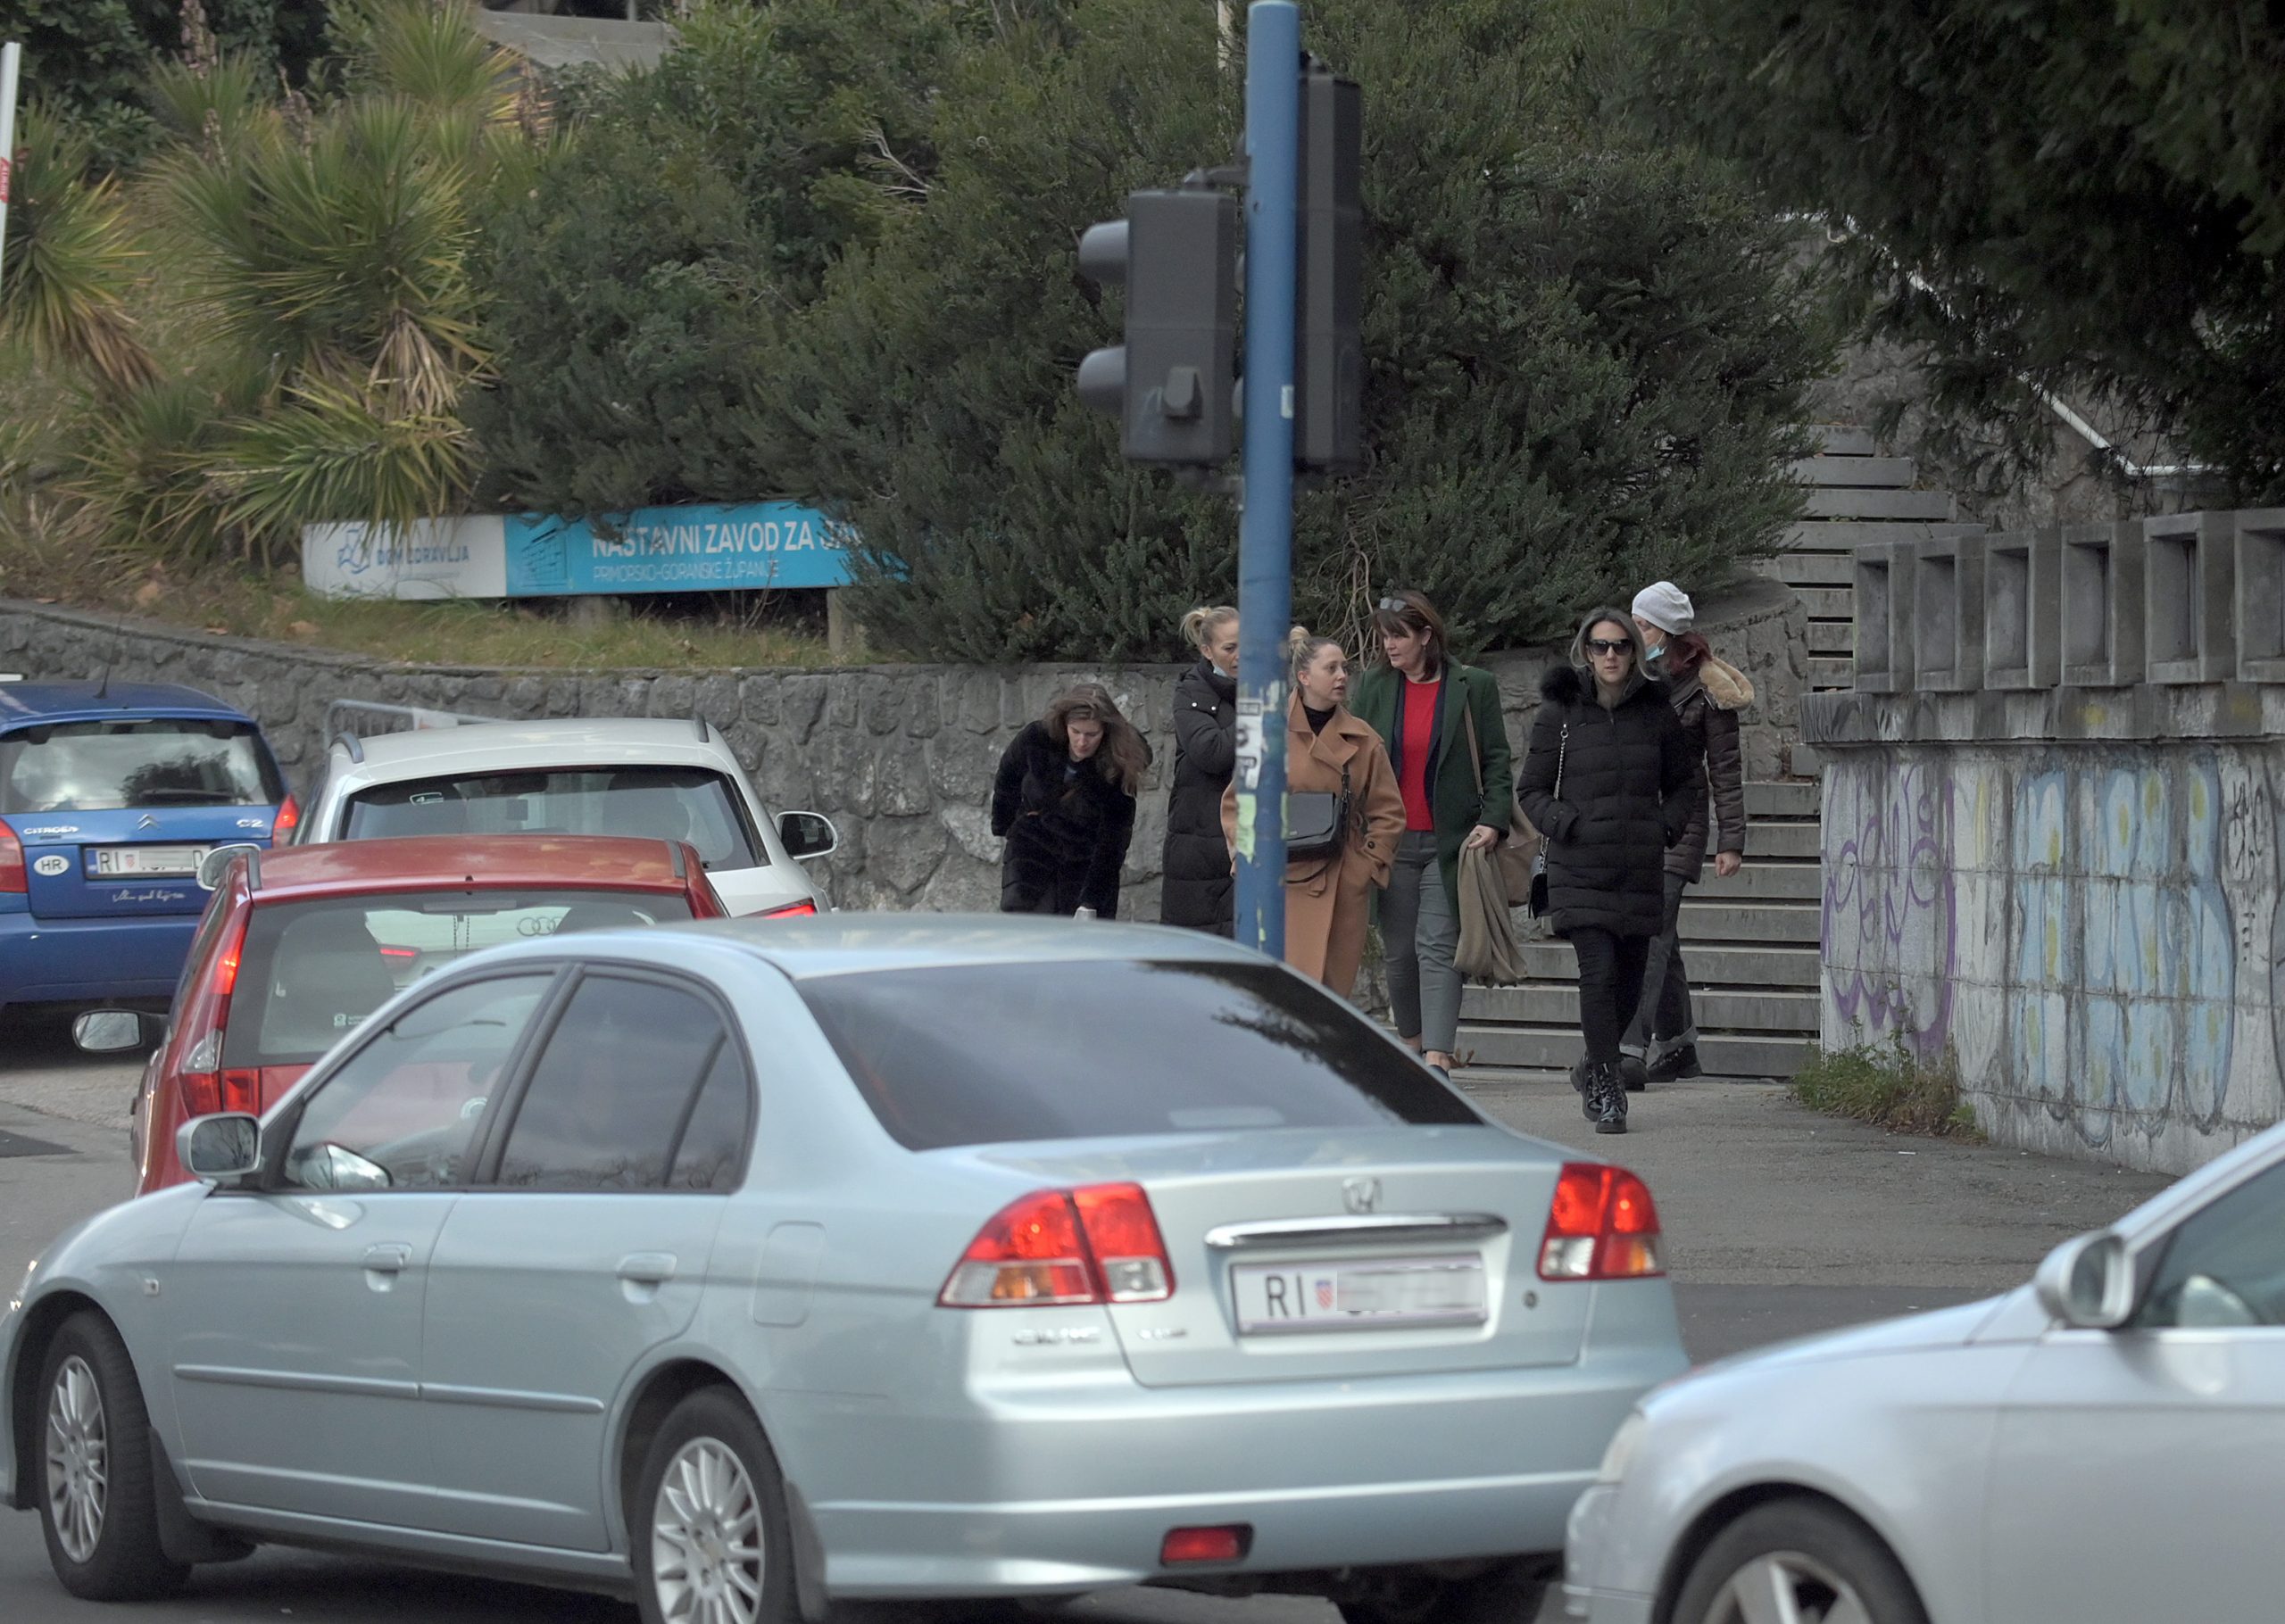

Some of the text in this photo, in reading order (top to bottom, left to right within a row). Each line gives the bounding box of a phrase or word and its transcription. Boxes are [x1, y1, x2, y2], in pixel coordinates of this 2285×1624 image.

[704, 523, 780, 553] ZAVOD
[784, 521, 816, 551] ZA
[236, 818, 264, 828] C2
[40, 862, 63, 872] HR
[1266, 1274, 1306, 1318] RI
